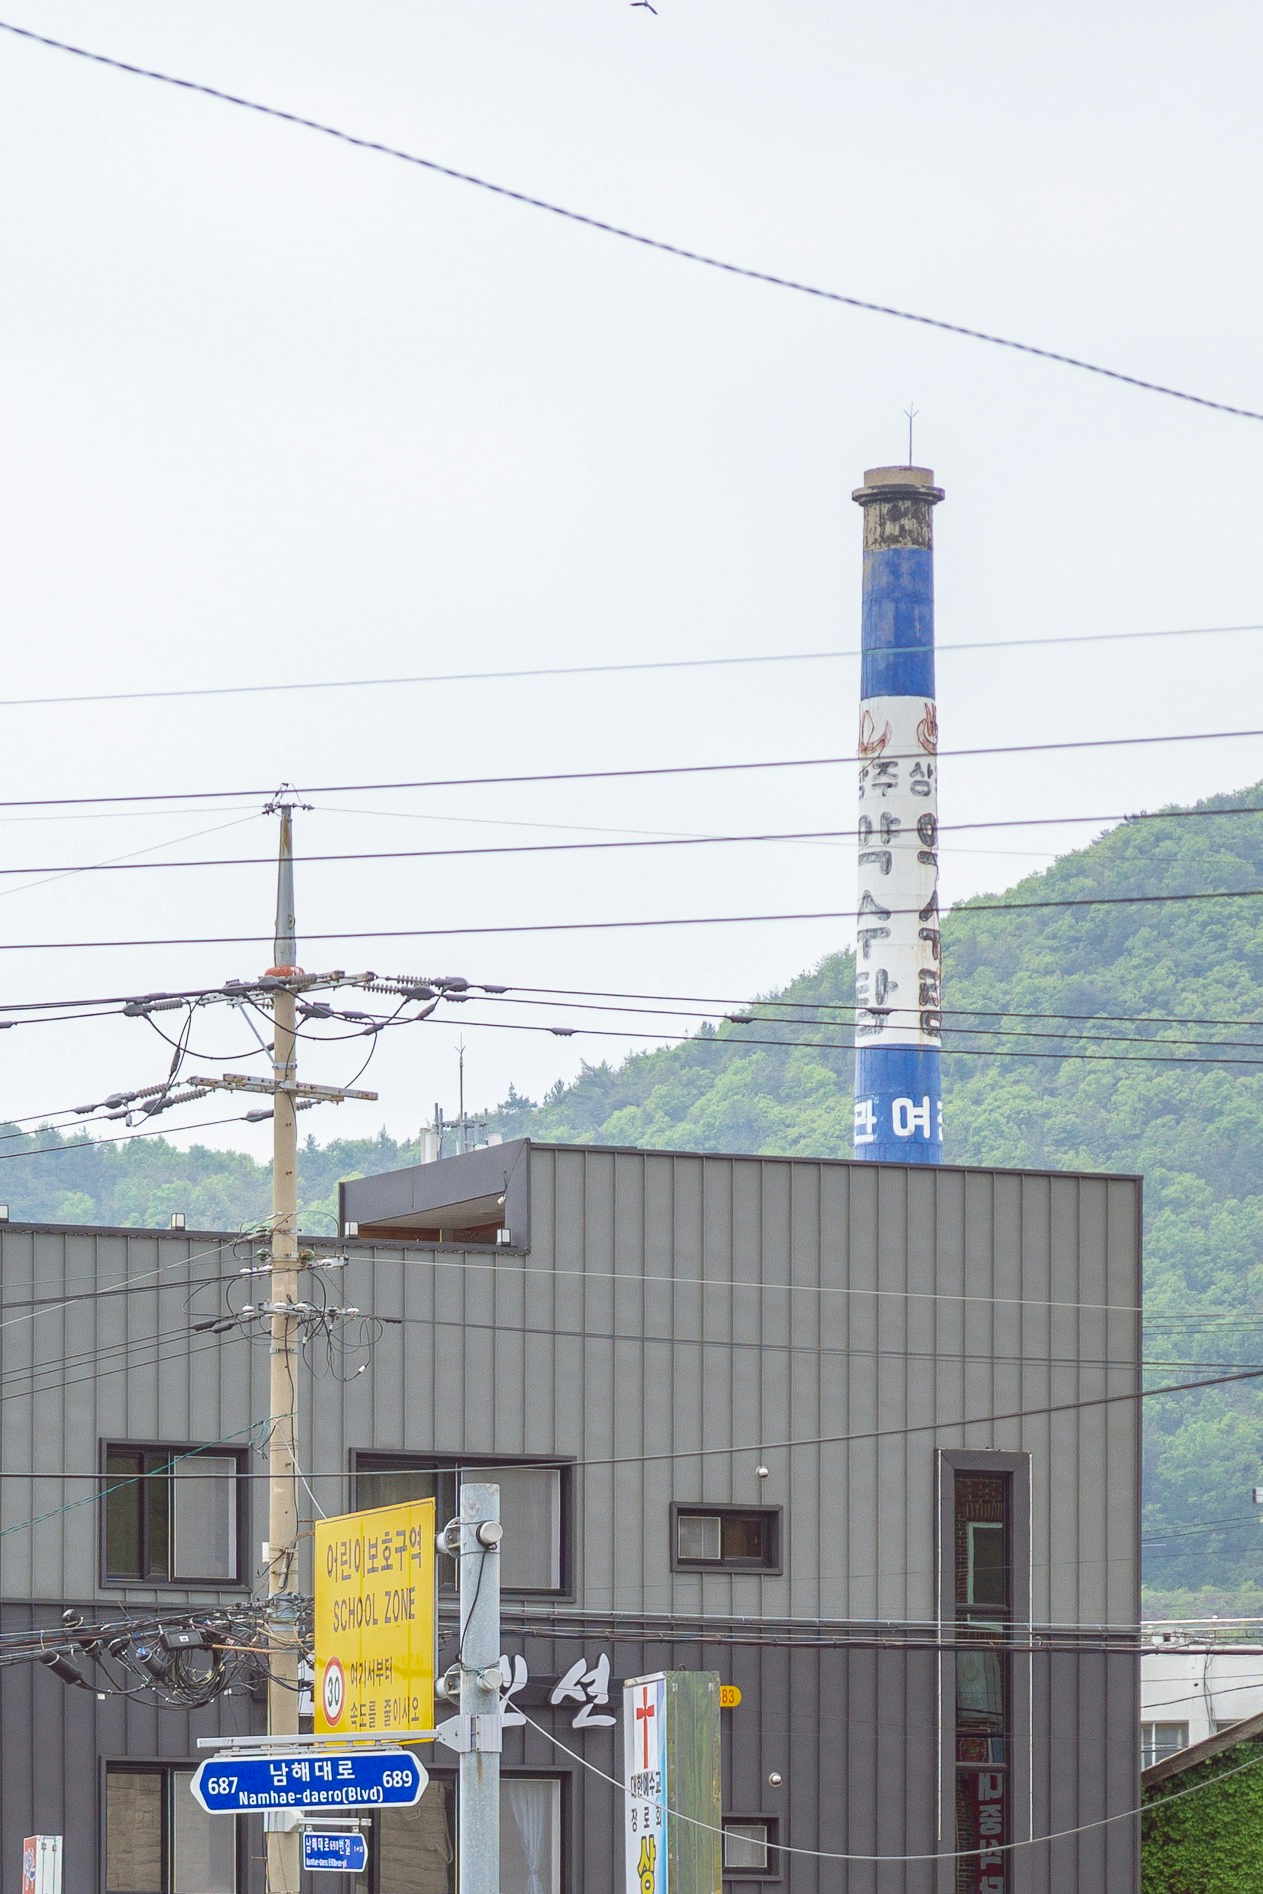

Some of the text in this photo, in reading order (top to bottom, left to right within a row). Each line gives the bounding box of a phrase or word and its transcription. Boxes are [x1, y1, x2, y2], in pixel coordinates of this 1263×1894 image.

[327, 1524, 422, 1583] 어린이보호구역
[333, 1586, 416, 1632] SCHOOL ZONE
[350, 1655, 393, 1689] 여기서부터
[327, 1675, 340, 1708] 30
[350, 1696, 420, 1730] 속도를 줄이시오
[207, 1776, 238, 1795] 687
[270, 1760, 356, 1786] 남해대로
[382, 1769, 413, 1788] 689
[630, 1770, 663, 1800] 대한예수교
[239, 1785, 384, 1806] Namhae-daero(Blvd)
